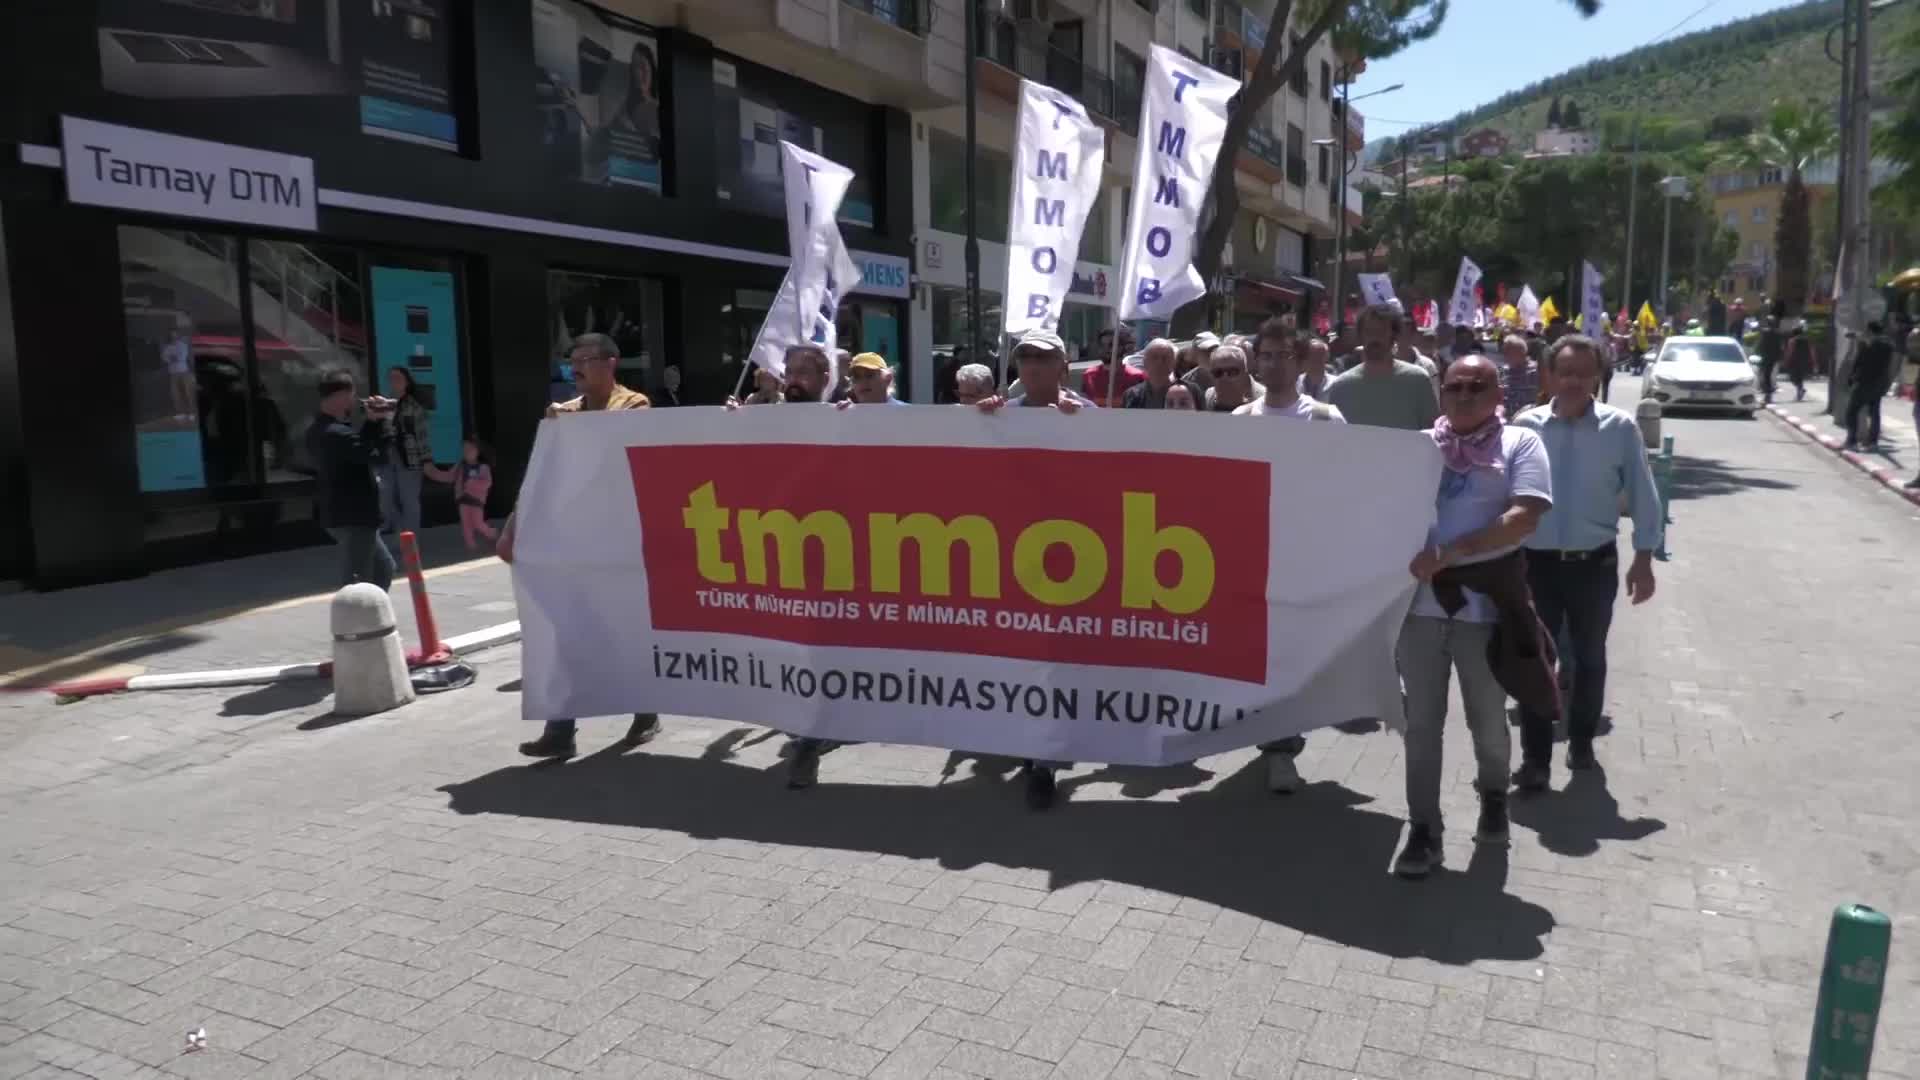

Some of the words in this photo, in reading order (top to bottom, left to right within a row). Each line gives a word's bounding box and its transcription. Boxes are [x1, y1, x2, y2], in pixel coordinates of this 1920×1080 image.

[84, 145, 215, 204] Tamay
[229, 166, 300, 208] DTM
[1027, 101, 1080, 318] TMMOB
[1137, 70, 1199, 305] TMMOB
[863, 262, 905, 288] MENS
[682, 480, 1215, 613] tmmob
[696, 588, 749, 609] TÜRK
[755, 594, 860, 619] MÜHENDİS
[869, 602, 899, 621] VE
[907, 602, 987, 626] MİMAR
[995, 610, 1101, 635] ODALARI
[1111, 616, 1208, 645] BİRLİĞİ
[653, 645, 739, 685] İZMİR
[749, 653, 772, 689] İL
[781, 663, 1078, 721] KOORDİNASYON
[1095, 689, 1261, 732] KURUL
